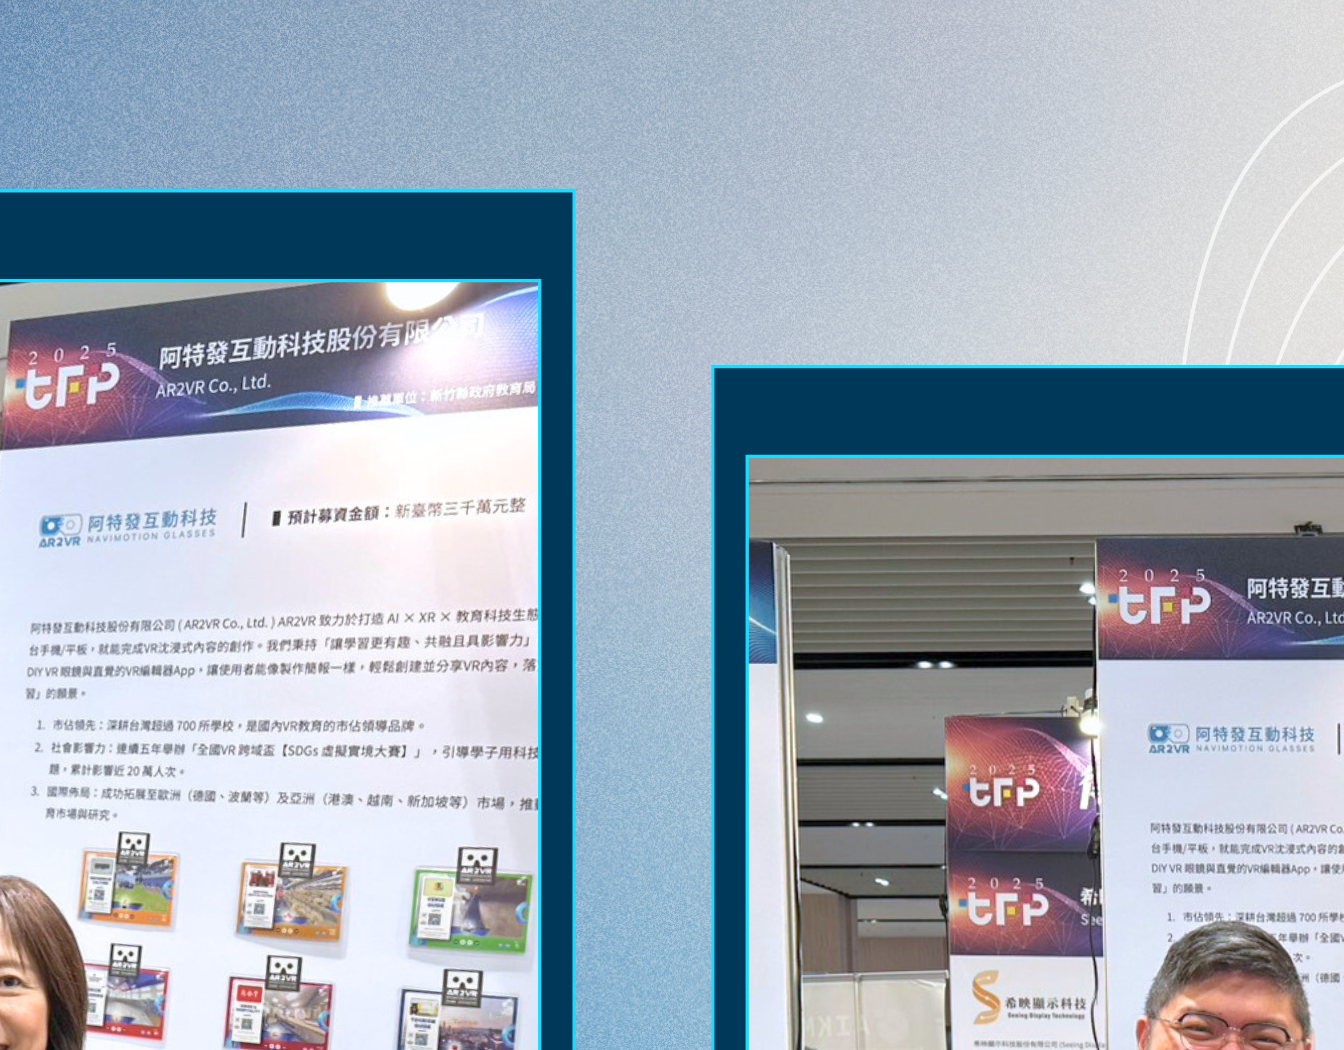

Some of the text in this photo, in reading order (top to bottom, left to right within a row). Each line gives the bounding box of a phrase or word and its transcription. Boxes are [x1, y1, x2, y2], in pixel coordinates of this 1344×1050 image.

[28, 342, 117, 366] 2025
[156, 373, 271, 399] AR2VR Co., Ltd.
[88, 508, 217, 533] 阿特發互動科技
[38, 536, 81, 549] AR2VR
[86, 529, 216, 544] NAVIMOTION GLASSES
[1119, 568, 1205, 583] 2025
[278, 615, 316, 628] AR2VR
[319, 612, 384, 628] 致力於打造
[387, 613, 399, 624] AI
[418, 611, 436, 623] XR
[1247, 612, 1292, 625] AR2VR
[1295, 611, 1322, 627] Co.,
[27, 666, 44, 678] DIY
[45, 666, 59, 678] VR
[177, 720, 196, 732] 700
[1195, 726, 1315, 743] 阿特發互動科技
[1148, 744, 1190, 755] AR2VR
[1196, 744, 1316, 753] NAVIMOTION GLASSES
[127, 765, 140, 777] 20
[969, 764, 1036, 775] 2025
[967, 877, 1044, 891] 2025
